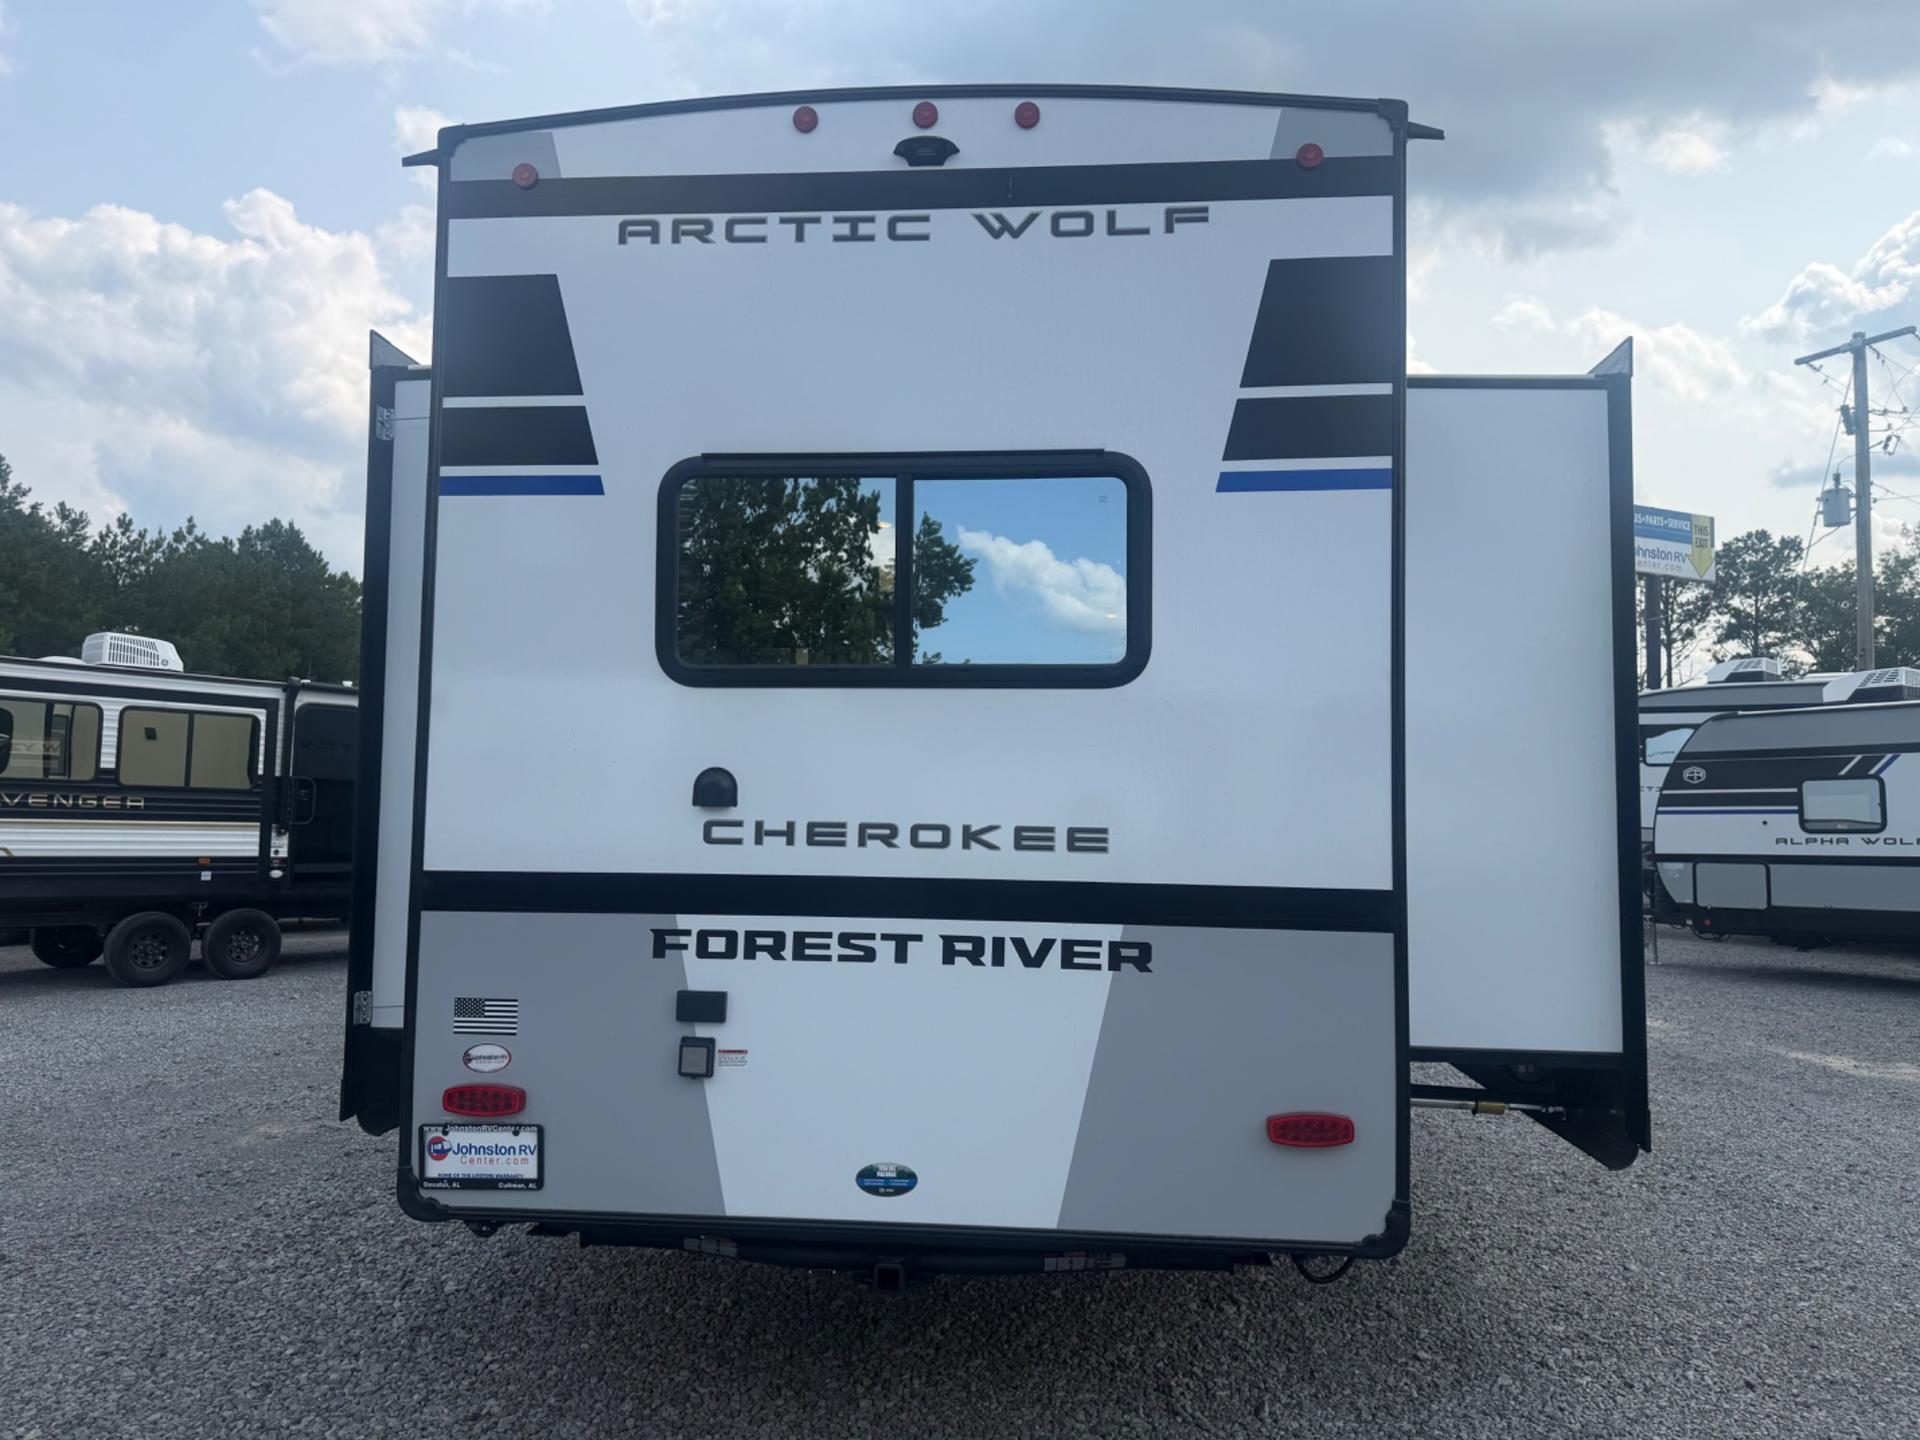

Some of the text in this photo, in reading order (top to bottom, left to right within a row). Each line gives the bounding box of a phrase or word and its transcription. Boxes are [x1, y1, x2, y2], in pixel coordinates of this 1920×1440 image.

[617, 206, 1209, 245] ARCTIC WOLF
[1635, 545, 1673, 562] hnston
[0, 793, 144, 809] VENGER
[702, 818, 1109, 854] CHEROKEE
[1775, 837, 1850, 846] ALPHA
[649, 929, 1153, 973] FOREST RIVER
[452, 1143, 538, 1156] Johnston RV
[459, 1156, 529, 1165] Center.com
